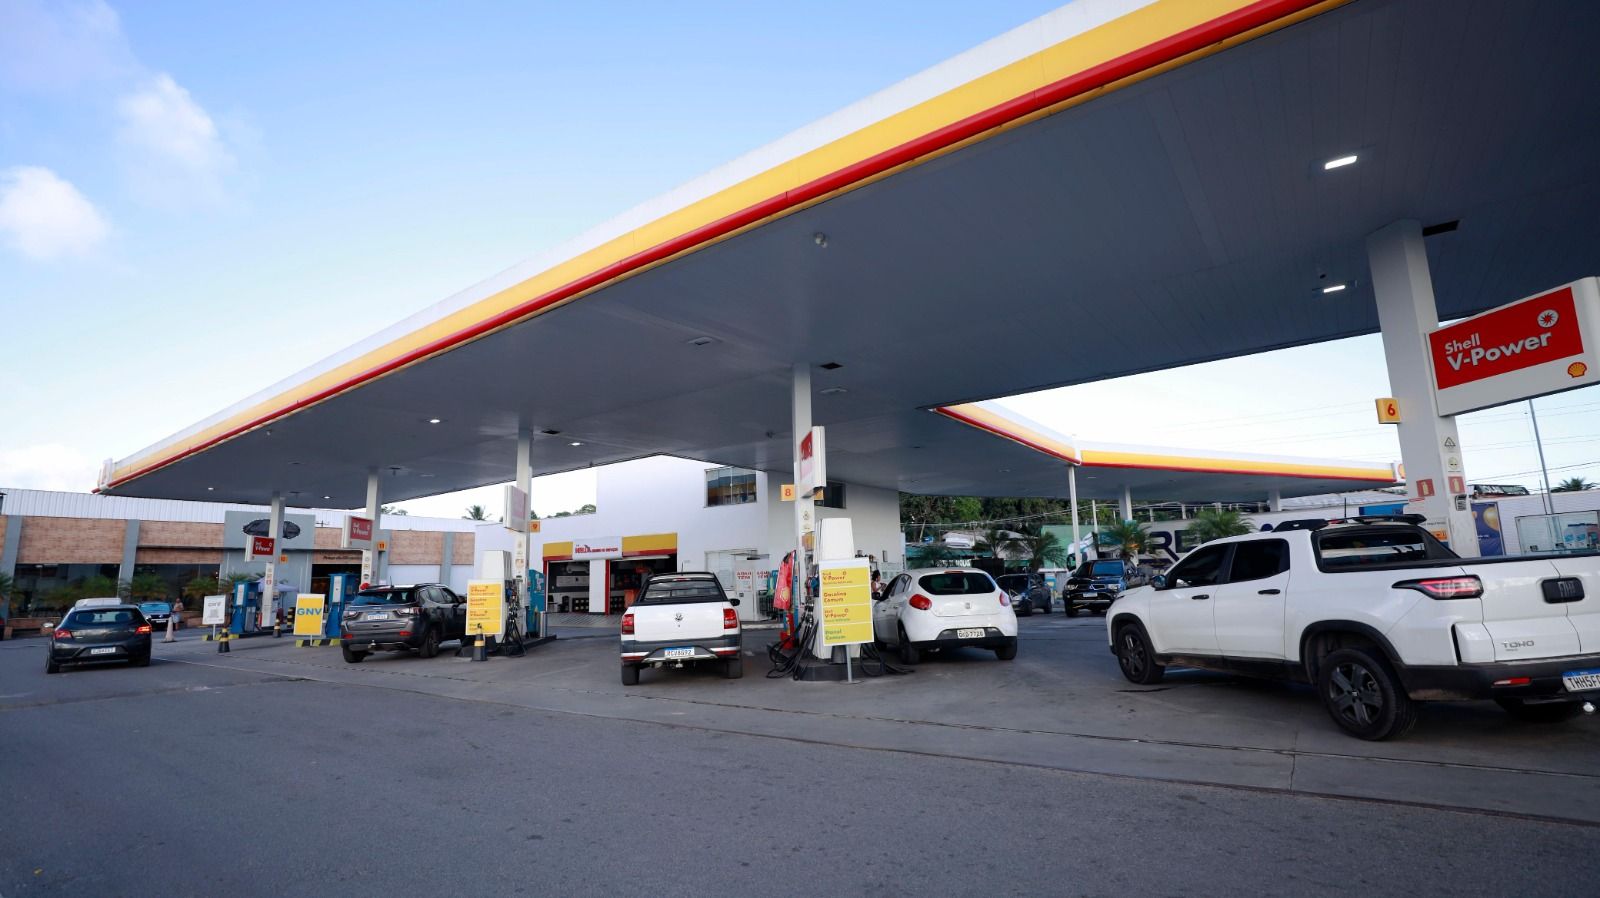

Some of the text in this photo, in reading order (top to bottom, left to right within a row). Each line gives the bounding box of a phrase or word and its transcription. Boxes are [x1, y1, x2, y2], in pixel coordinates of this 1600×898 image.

[1445, 333, 1480, 355] Shell
[1447, 332, 1552, 371] V-Power
[1387, 403, 1396, 416] 6
[785, 488, 792, 497] 8
[296, 607, 324, 616] GNV
